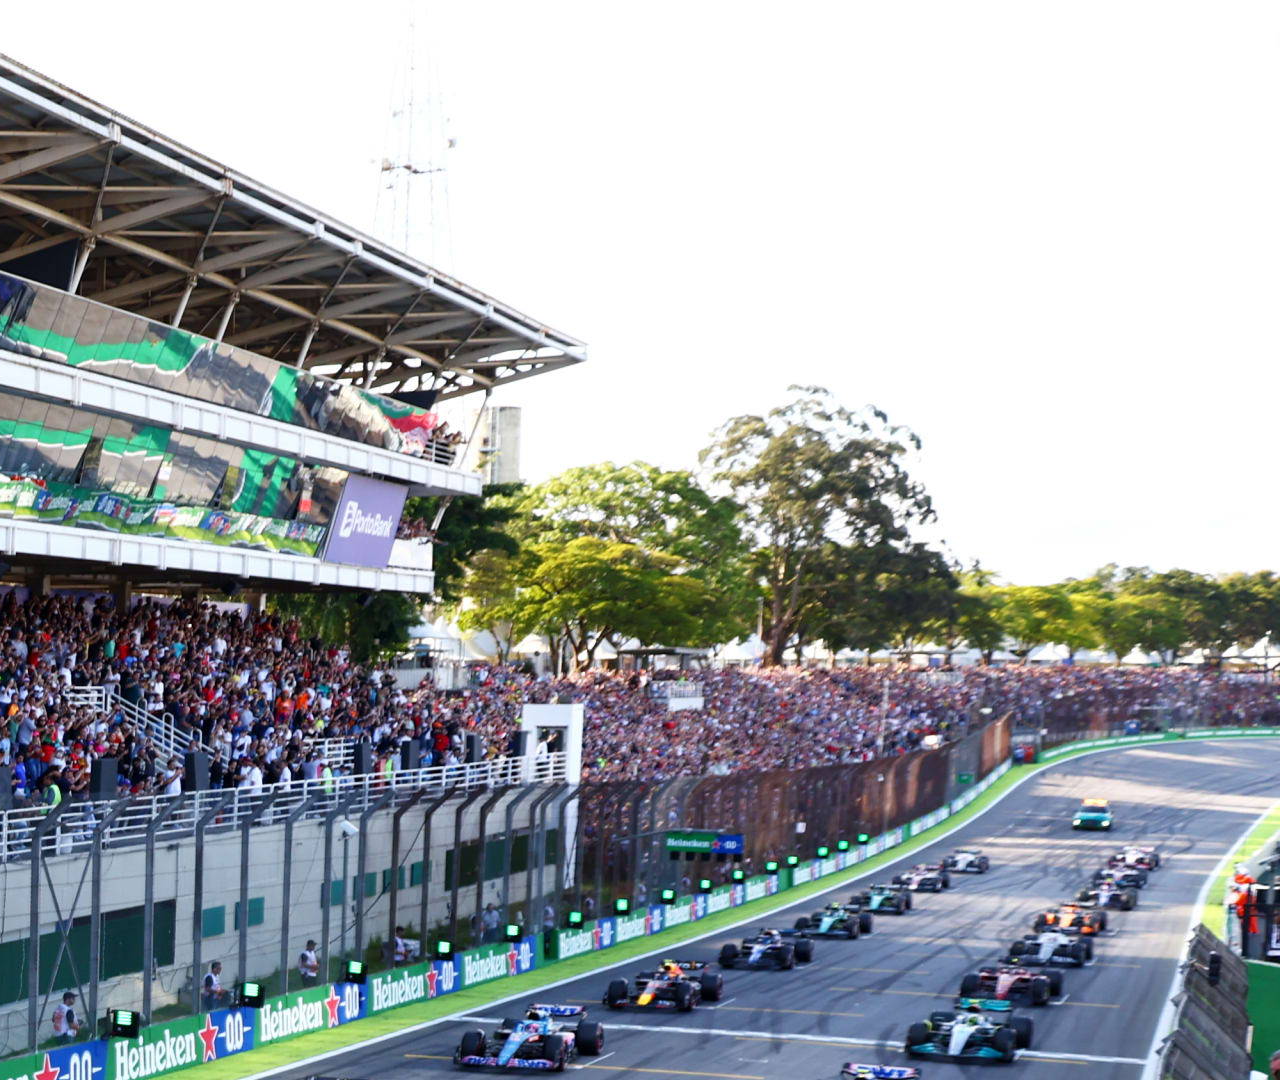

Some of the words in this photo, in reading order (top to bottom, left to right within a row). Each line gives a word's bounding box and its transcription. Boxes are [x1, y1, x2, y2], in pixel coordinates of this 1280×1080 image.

[667, 838, 710, 848] Heineken
[559, 929, 593, 959] Heineken
[372, 967, 425, 1012] Heineken
[441, 960, 455, 990] 0.0
[464, 949, 507, 985] Heineken
[259, 997, 324, 1042] Heineken
[344, 982, 360, 1019] 0.0
[225, 1012, 244, 1052] 0.0
